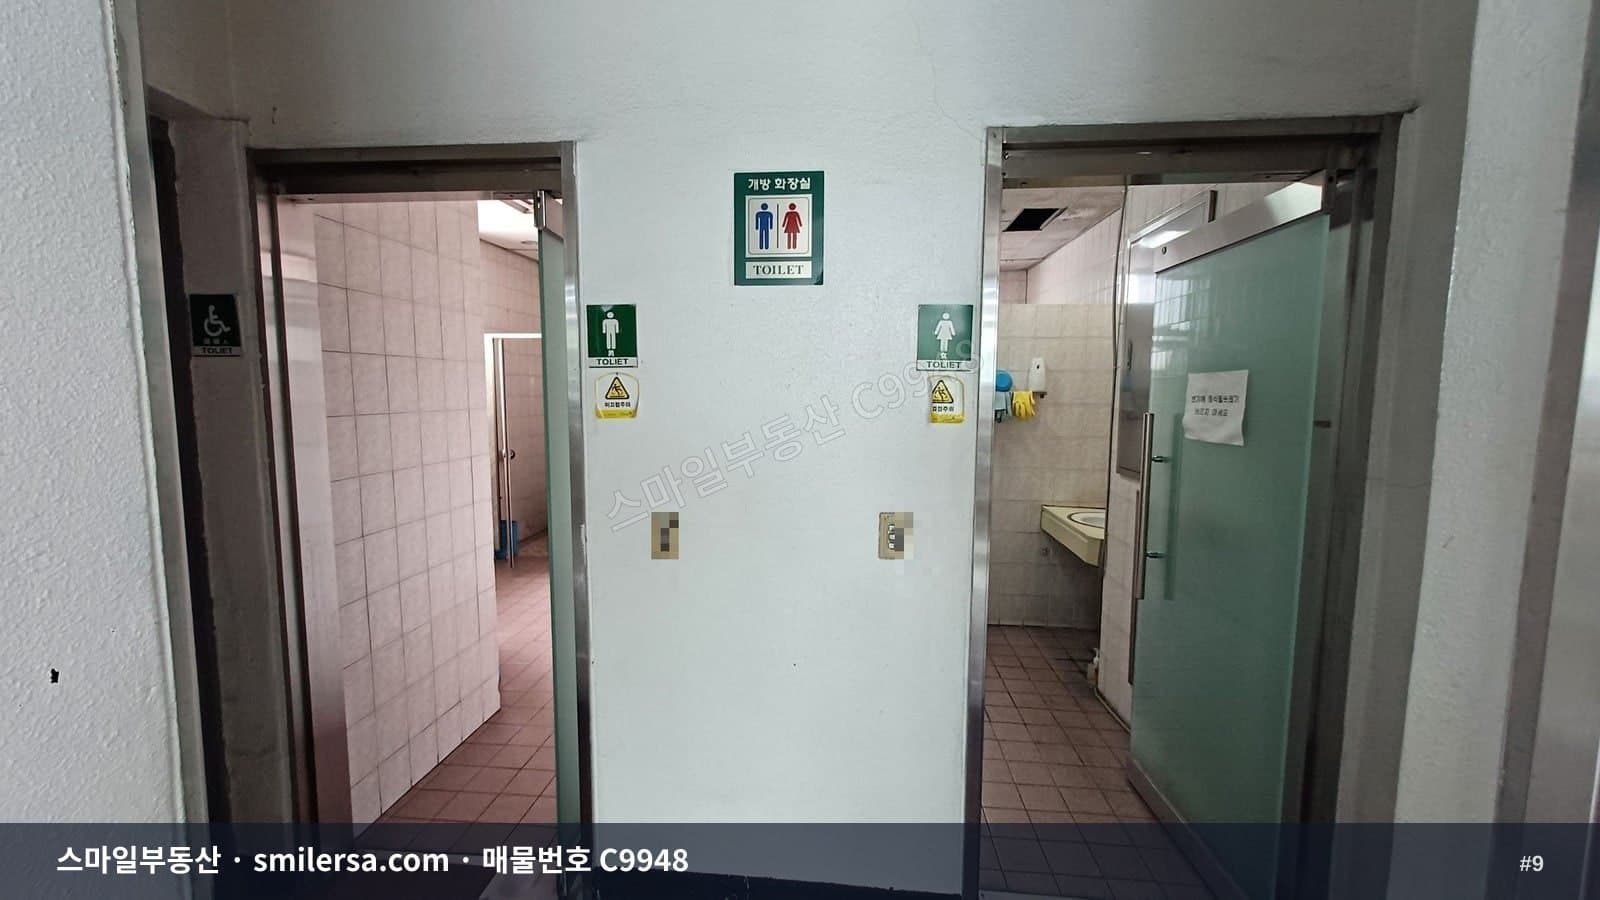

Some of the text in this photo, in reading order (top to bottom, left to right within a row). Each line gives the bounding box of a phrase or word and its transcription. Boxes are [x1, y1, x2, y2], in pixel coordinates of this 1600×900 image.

[748, 177, 811, 191] 개방 화장실
[752, 264, 805, 276] TOILET
[596, 358, 629, 366] TOLIET
[926, 361, 962, 369] TOLIET
